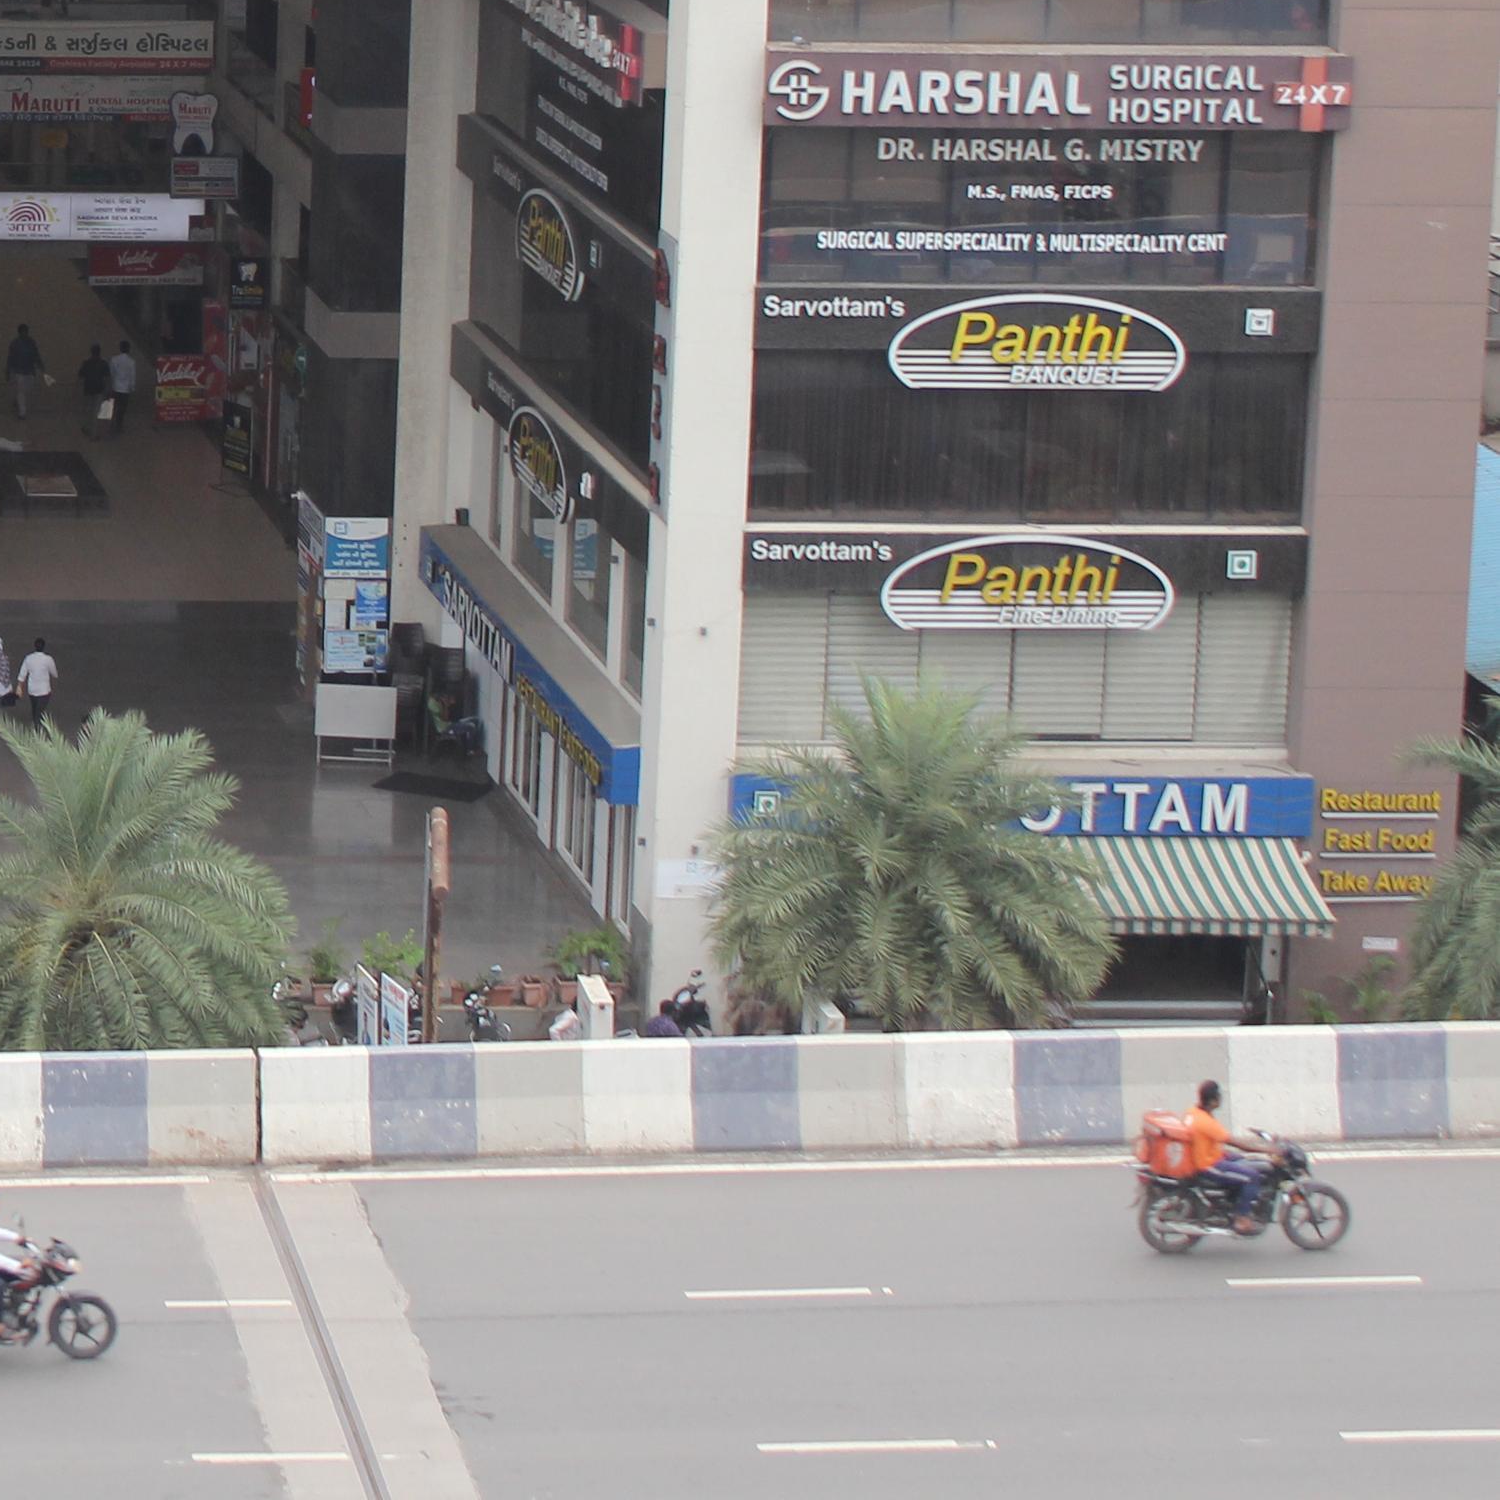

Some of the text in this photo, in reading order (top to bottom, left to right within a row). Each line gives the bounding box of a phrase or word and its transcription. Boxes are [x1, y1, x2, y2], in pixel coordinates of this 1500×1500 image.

[841, 64, 1265, 117] HARSHAL SURGICAL
[1108, 97, 1264, 125] HOSPITAL
[877, 138, 1203, 162] DR. HARSHAL G. MISTRY
[1065, 185, 1113, 200] FICPS
[817, 231, 892, 250] SURGICAL
[896, 232, 1031, 252] SUPERSPECIALITY
[1049, 234, 1184, 253] MULTISPECIALITY
[1188, 234, 1227, 252] CENT
[762, 295, 905, 318] Sarvottam's
[950, 311, 1133, 367] Panthi
[1009, 364, 1123, 385] BANQUET
[751, 540, 893, 563] Sarvottam's
[940, 552, 1121, 606] Panthi
[1321, 788, 1442, 812] Restaurant
[1325, 828, 1433, 851] Fast Food
[1320, 869, 1433, 897] Take Away
